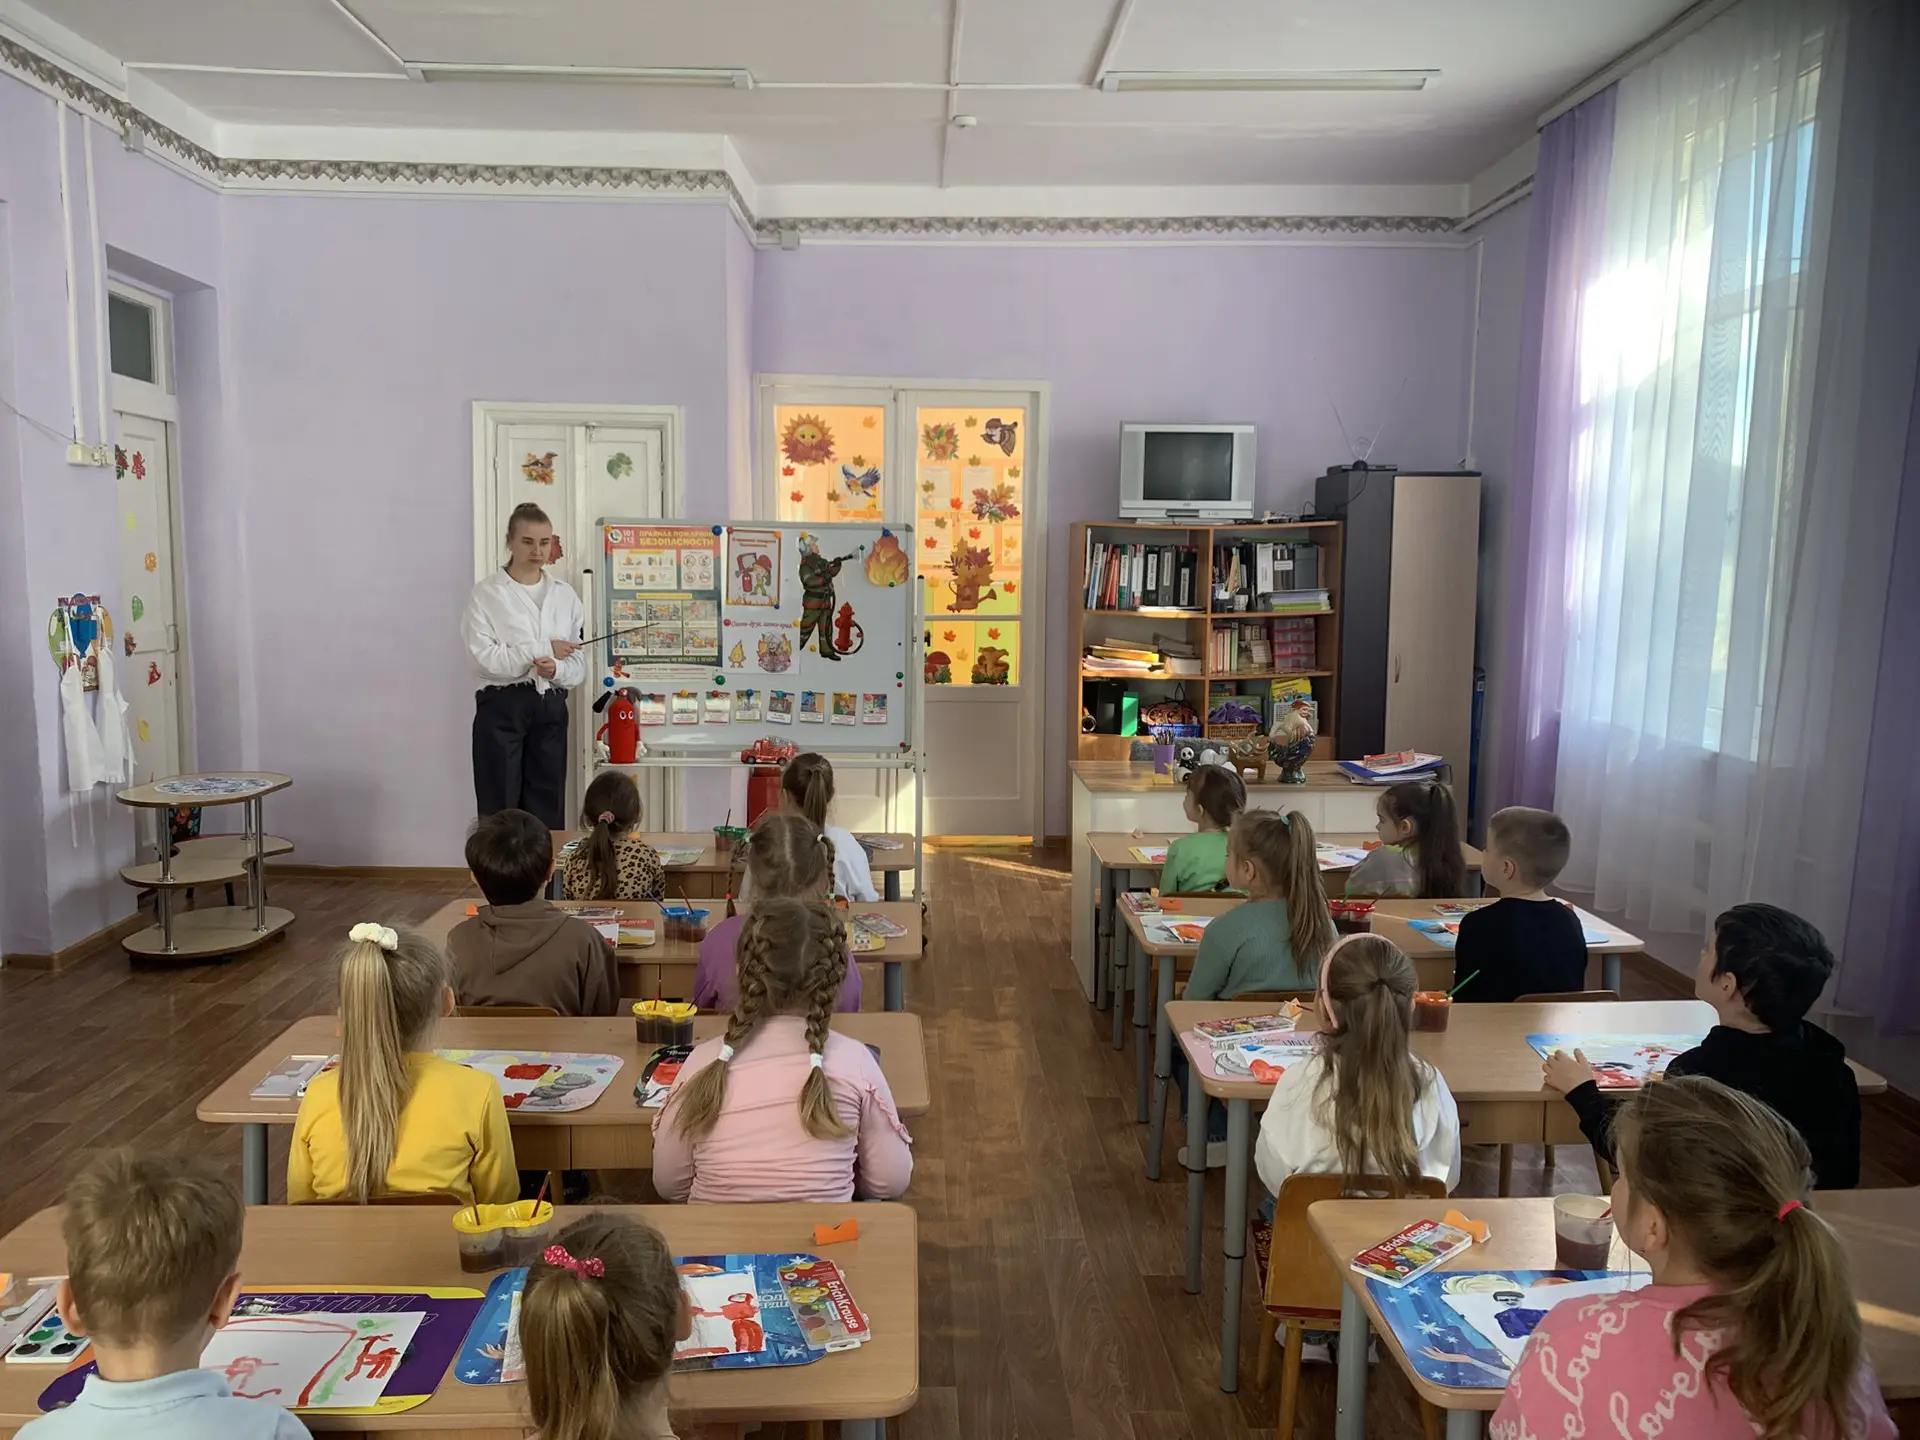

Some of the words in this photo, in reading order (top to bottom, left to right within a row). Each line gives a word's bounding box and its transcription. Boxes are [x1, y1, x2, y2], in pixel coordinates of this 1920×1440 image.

[639, 538, 714, 546] БЕЗОПАСНОСТИ
[1378, 1222, 1434, 1252] ErichKrause
[827, 1280, 859, 1329] ErichKrause
